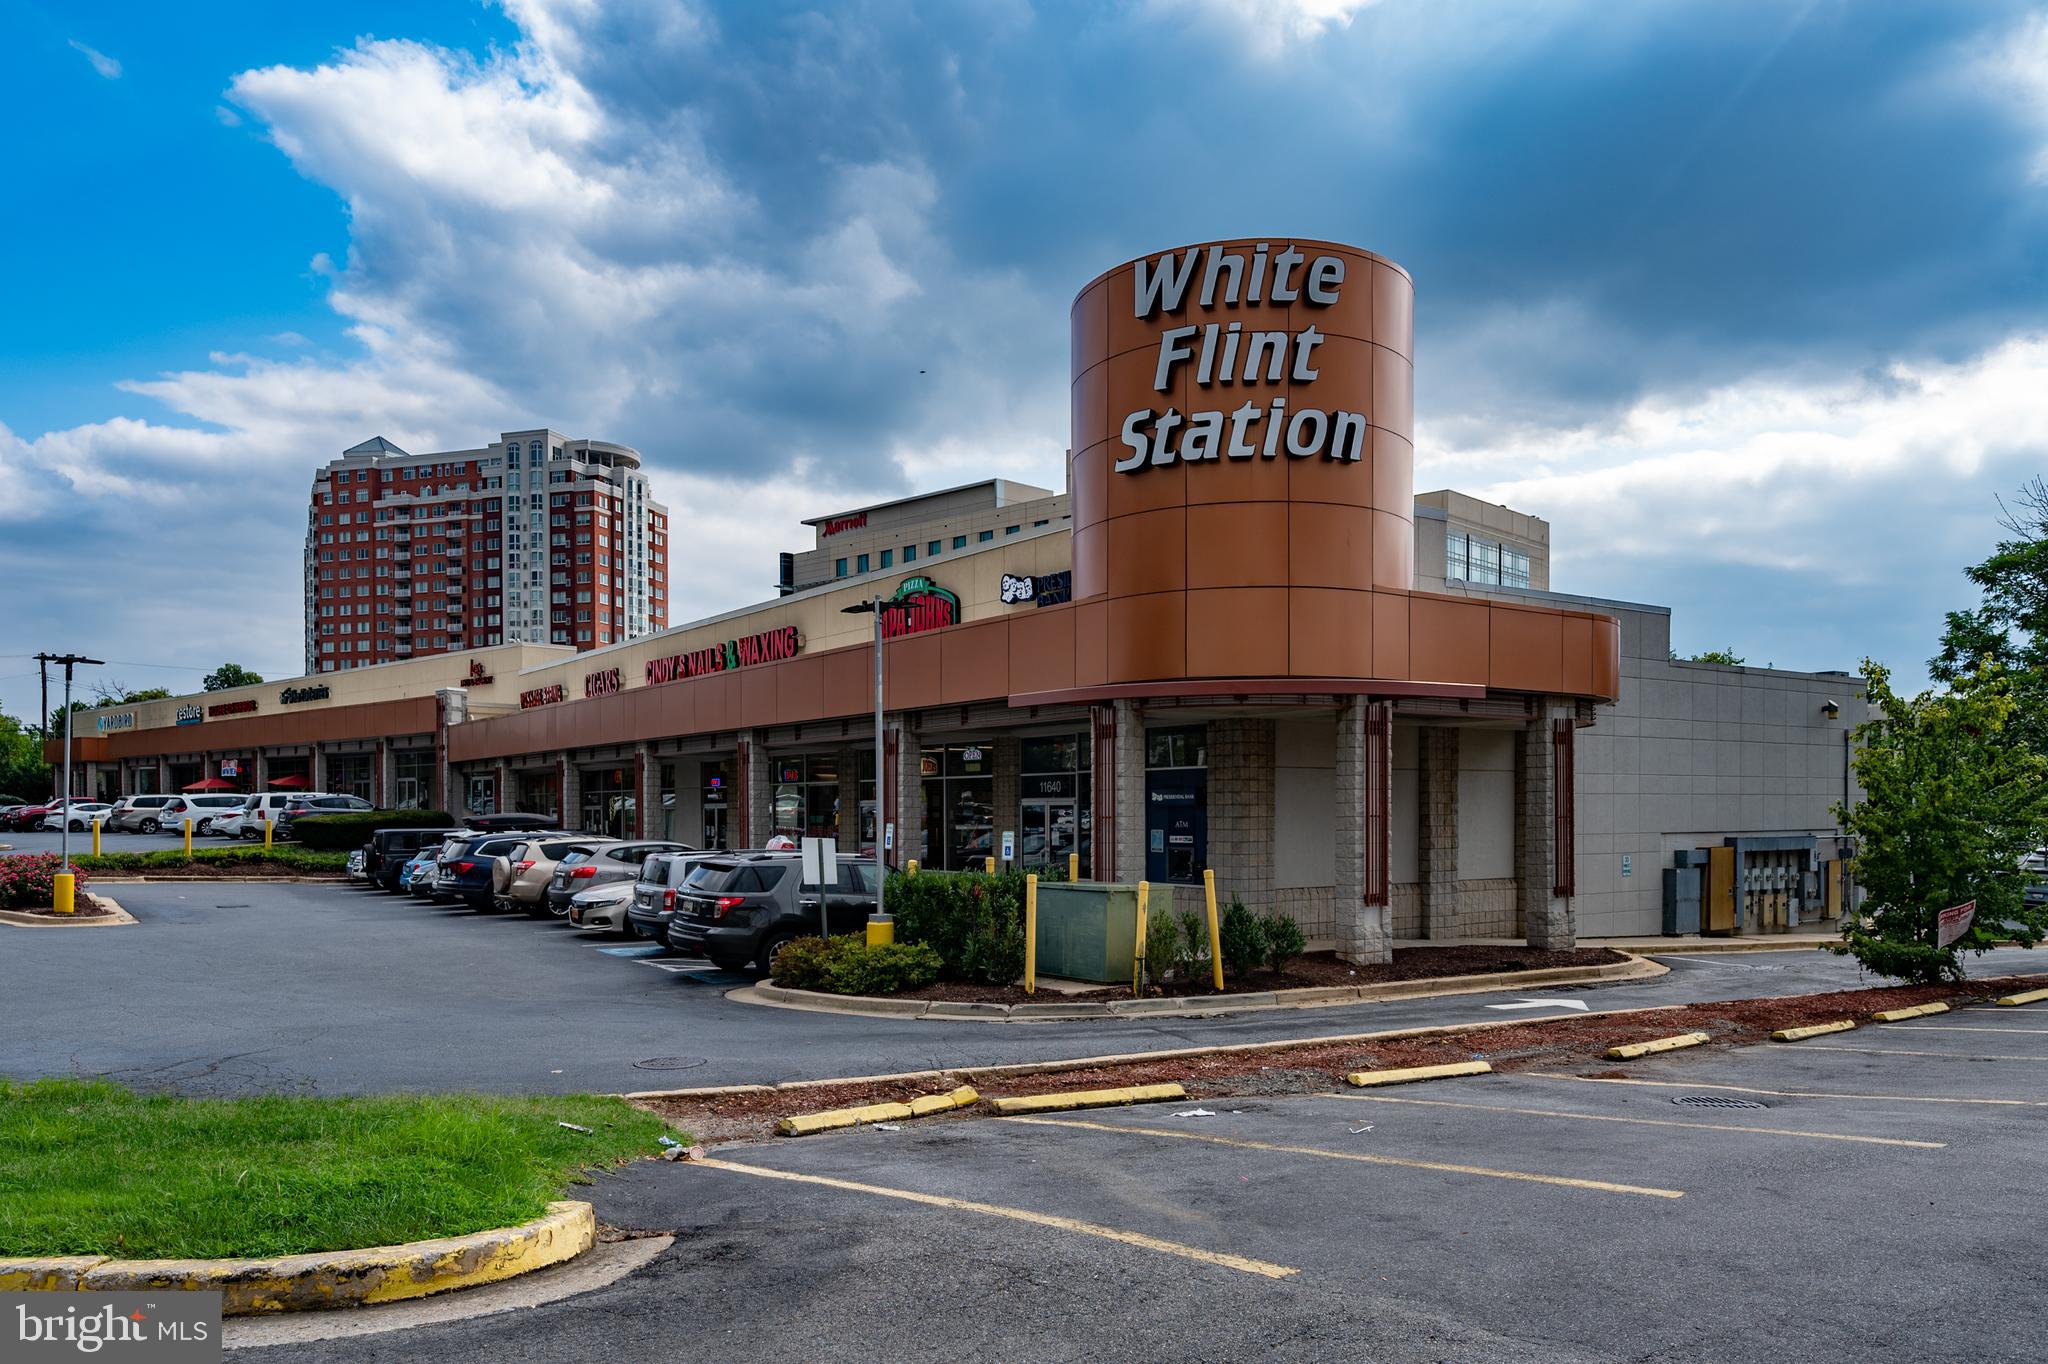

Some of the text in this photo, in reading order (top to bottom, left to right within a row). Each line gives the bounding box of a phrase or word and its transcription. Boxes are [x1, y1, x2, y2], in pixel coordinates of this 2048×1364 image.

[1134, 242, 1346, 319] White
[1153, 321, 1325, 391] Flint
[1114, 397, 1367, 474] Station
[822, 512, 867, 537] Marriott
[903, 578, 924, 592] PIZZA
[645, 626, 797, 687] CINDY'S NAILS & WAXING
[584, 668, 619, 698] CIGARS
[176, 703, 201, 721] restore
[1039, 780, 1062, 793] 11640
[1174, 820, 1189, 829] ATM
